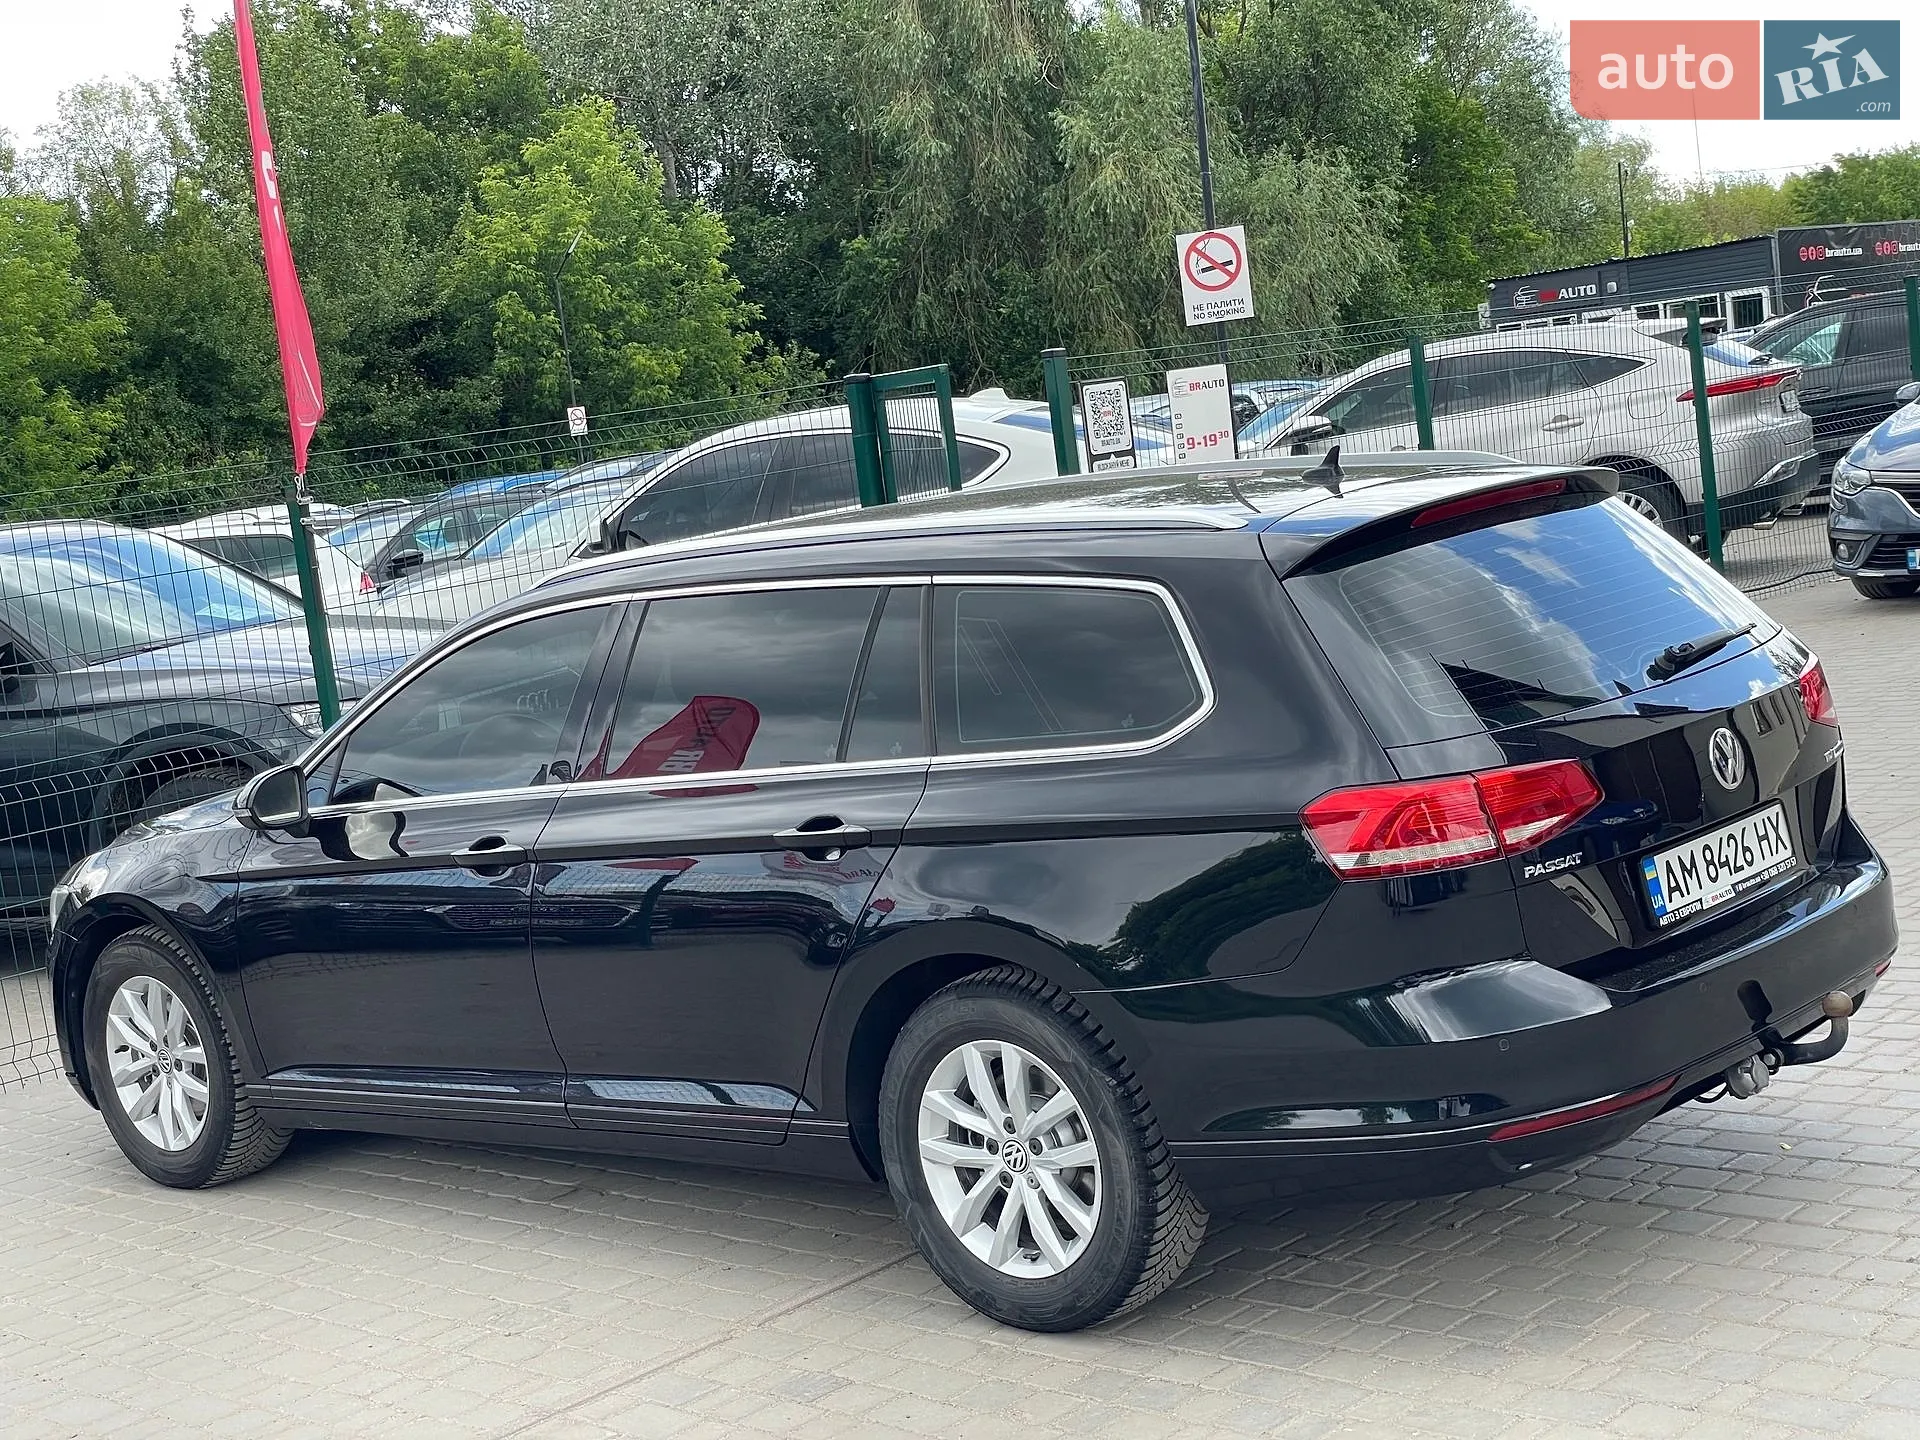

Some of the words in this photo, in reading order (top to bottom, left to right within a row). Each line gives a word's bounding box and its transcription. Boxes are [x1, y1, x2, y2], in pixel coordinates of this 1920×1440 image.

[1825, 246, 1863, 258] brauto.ua
[1192, 303, 1205, 312] НЕ
[1206, 297, 1245, 310] ПАЛИТИ
[1193, 312, 1206, 320] NO
[1207, 306, 1246, 319] SMOKING
[1189, 378, 1225, 392] BRAUTO
[1665, 849, 1703, 903] AM
[1702, 827, 1754, 884] 8426
[1754, 811, 1788, 861] HX
[1523, 852, 1583, 879] PASSAT
[1651, 894, 1664, 909] UA
